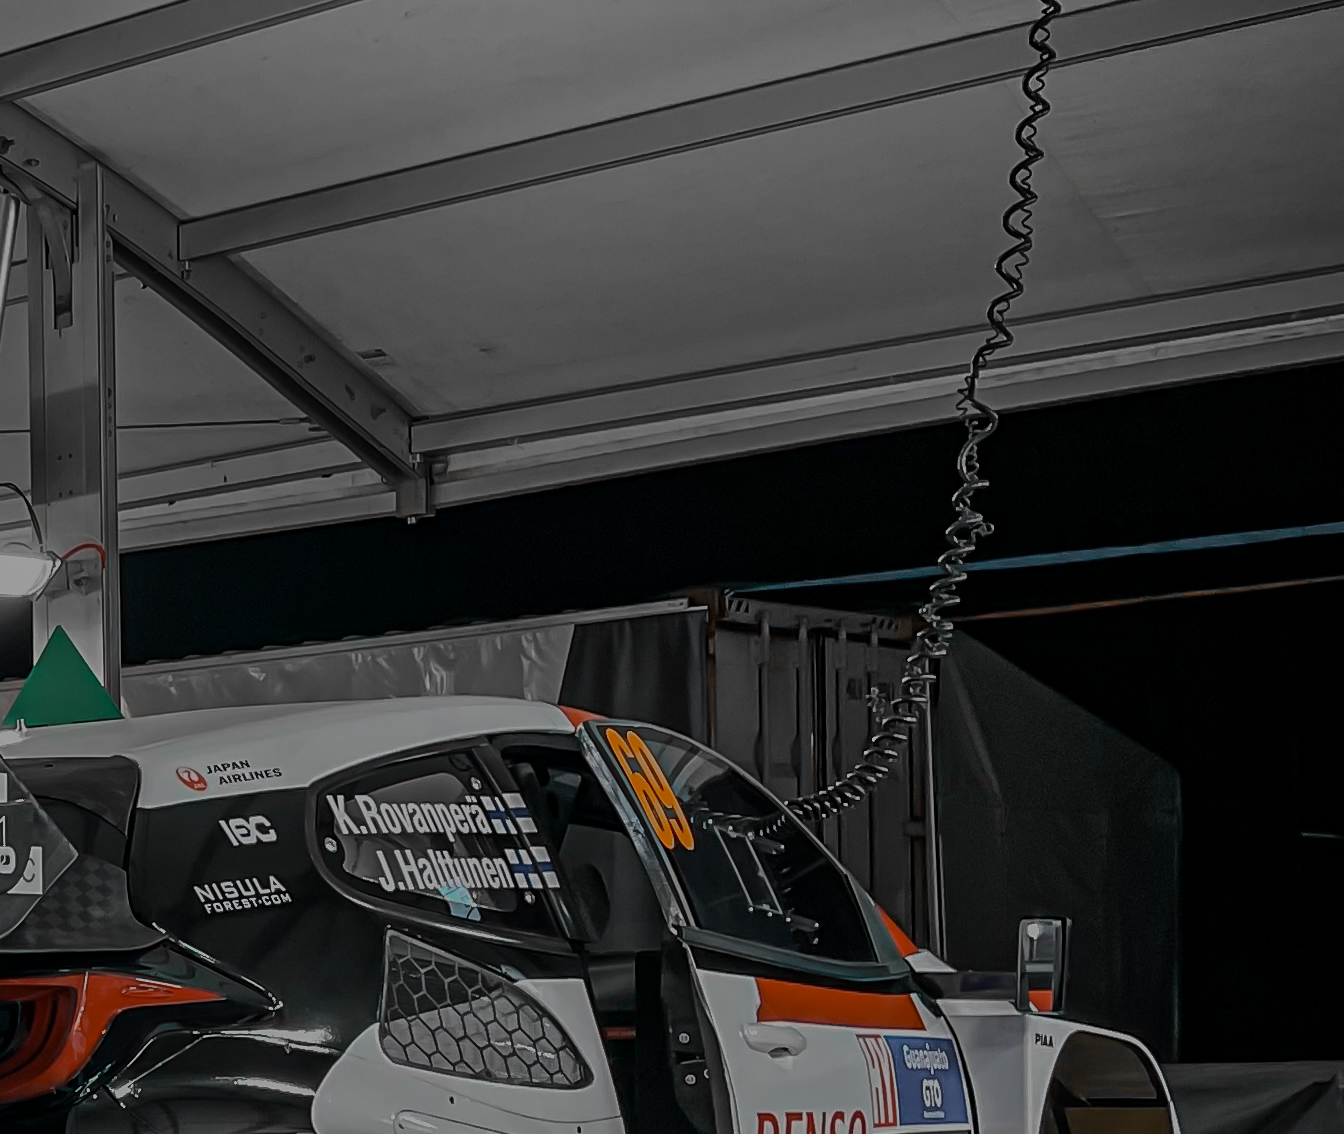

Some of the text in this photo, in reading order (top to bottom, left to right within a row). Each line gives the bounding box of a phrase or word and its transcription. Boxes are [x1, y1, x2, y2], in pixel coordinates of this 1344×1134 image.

[206, 759, 251, 775] JAPAN
[218, 767, 283, 786] AIRLINES
[325, 794, 492, 843] K.Rovanperä
[375, 848, 515, 893] J.Halttunen
[192, 874, 287, 903] NISULA
[1035, 1033, 1054, 1048] PIAA
